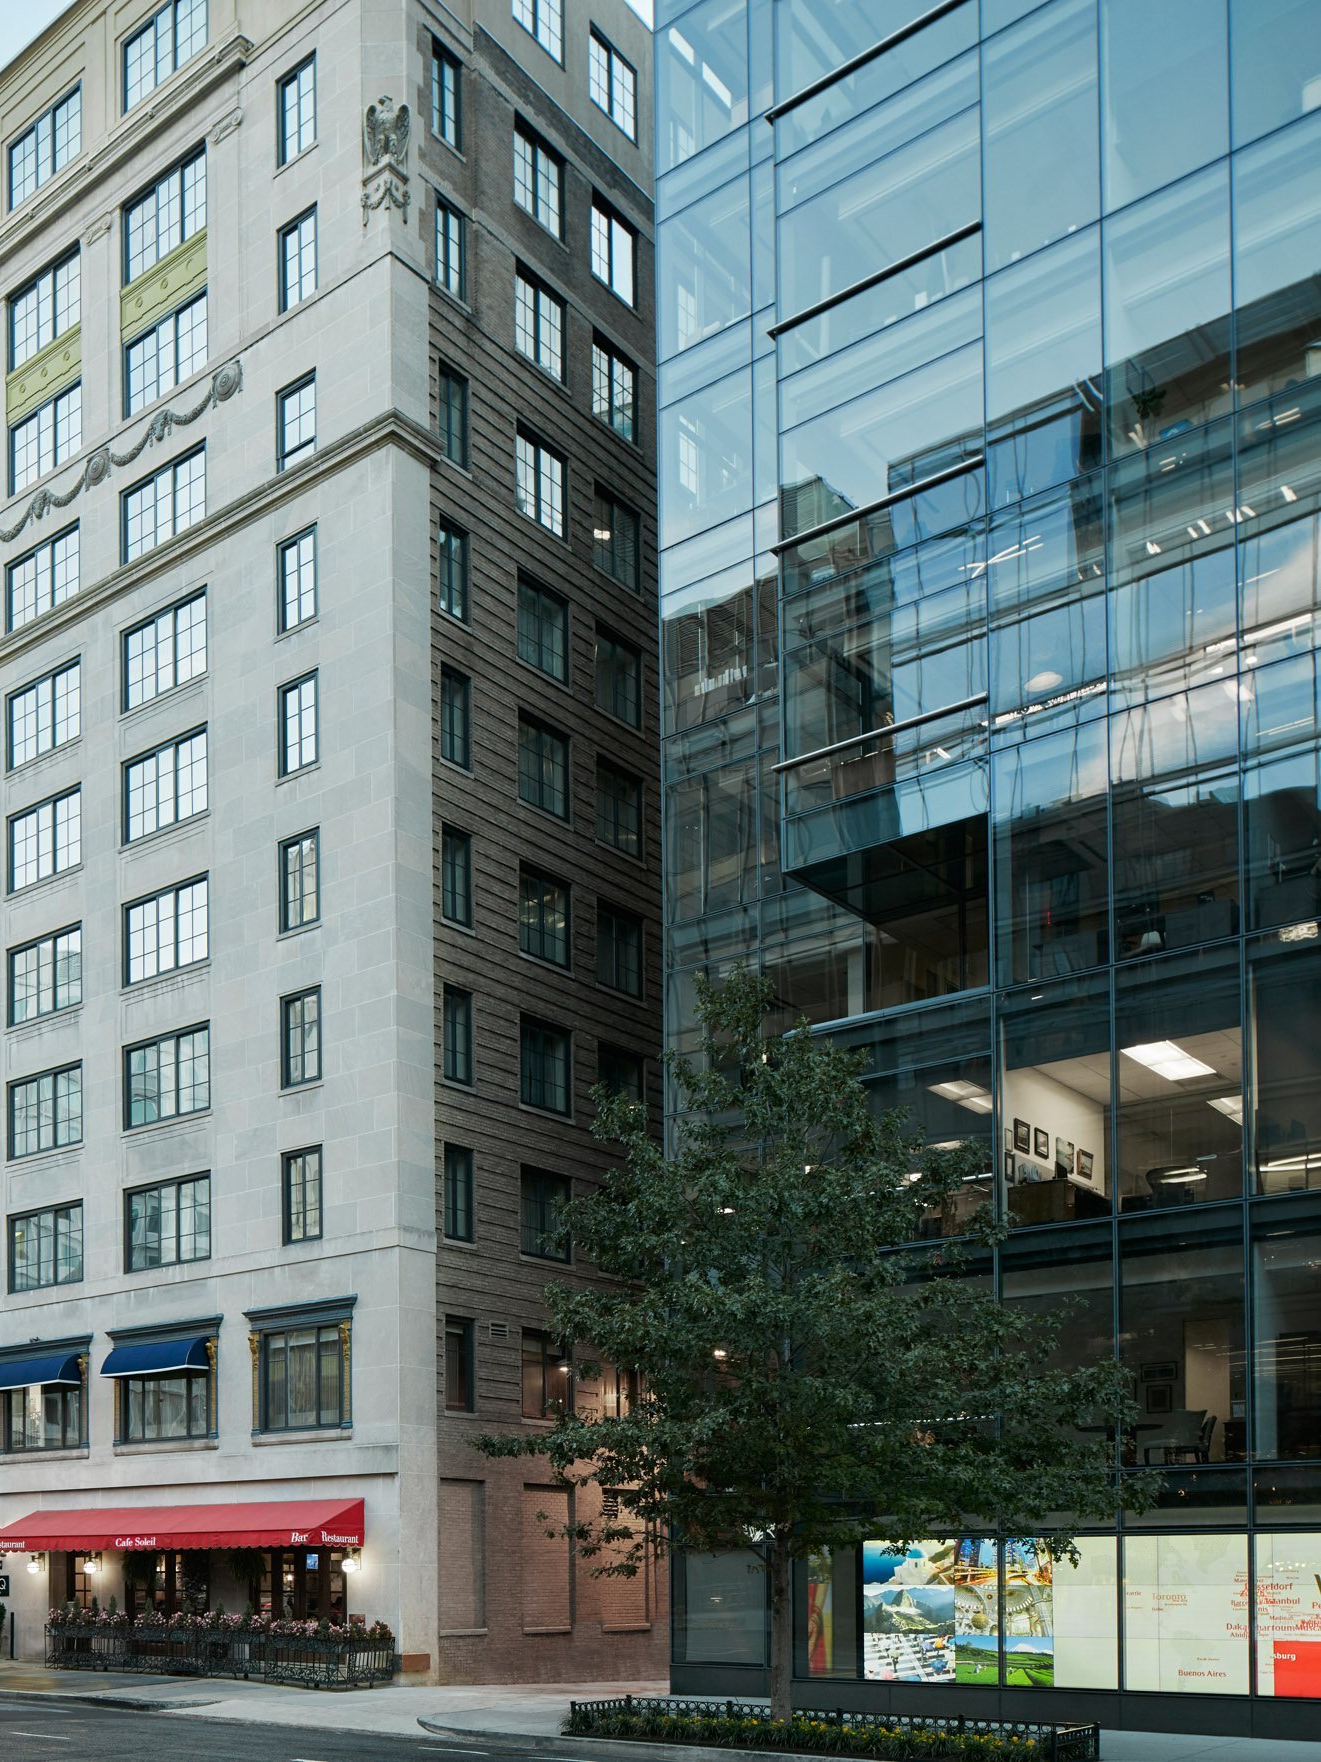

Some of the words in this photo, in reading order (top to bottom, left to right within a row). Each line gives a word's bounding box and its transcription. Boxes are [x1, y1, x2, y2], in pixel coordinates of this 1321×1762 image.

[115, 1537, 133, 1547] Cafe
[134, 1536, 156, 1547] Soleil
[291, 1531, 309, 1543] Bar
[321, 1530, 359, 1544] Restaurant
[1151, 1592, 1187, 1601] Toronto
[1178, 1669, 1205, 1677] Buenos
[1207, 1669, 1227, 1677] Aires
